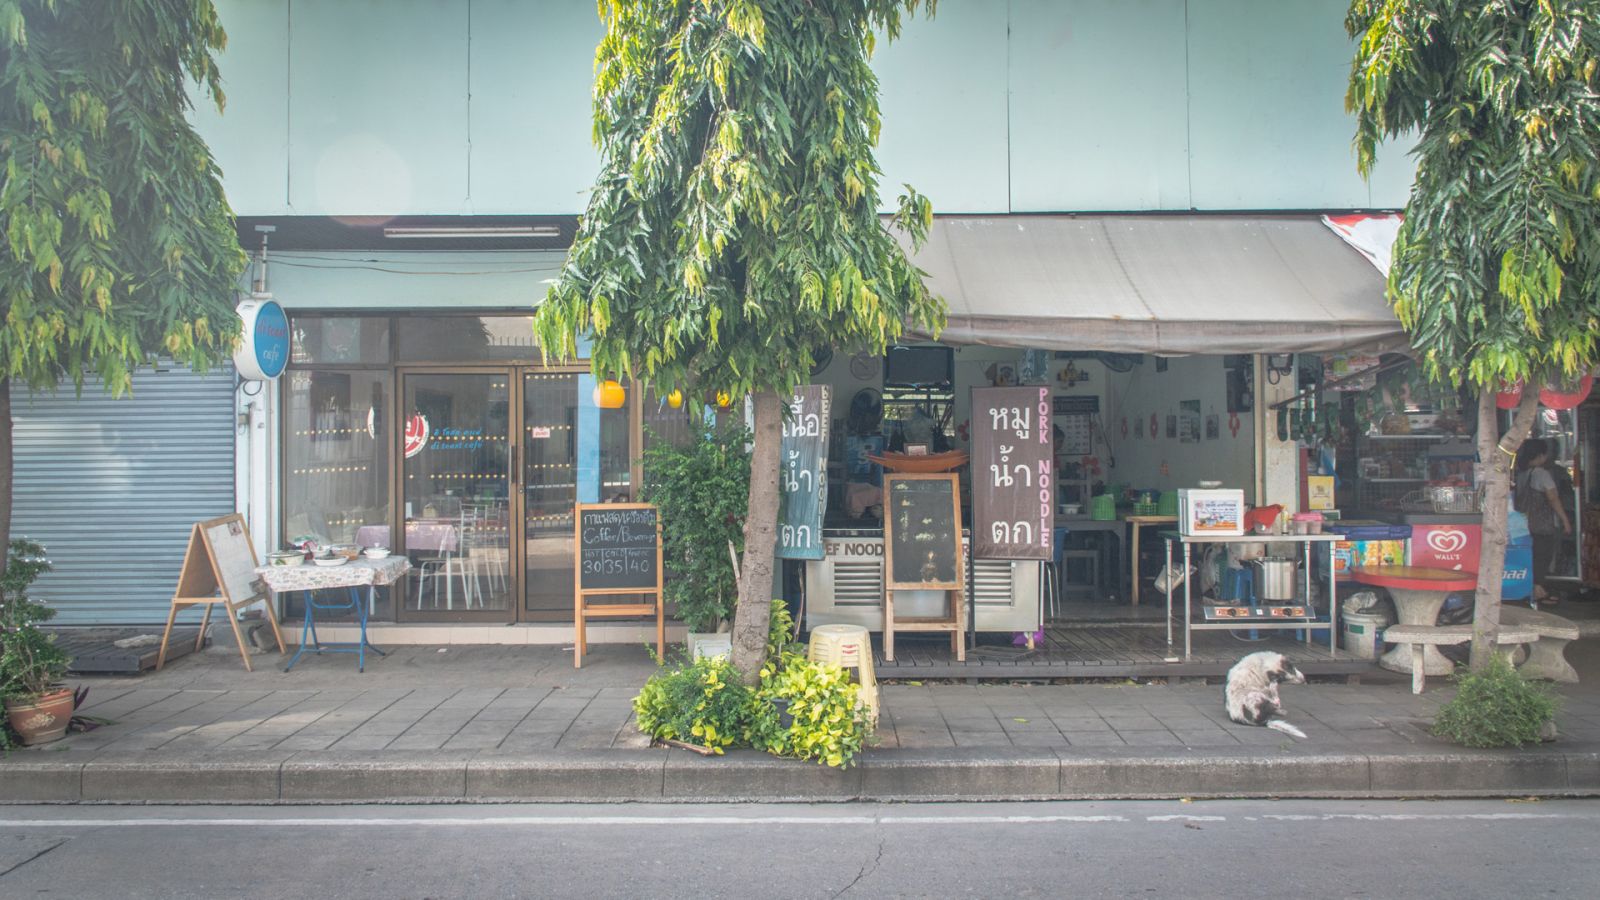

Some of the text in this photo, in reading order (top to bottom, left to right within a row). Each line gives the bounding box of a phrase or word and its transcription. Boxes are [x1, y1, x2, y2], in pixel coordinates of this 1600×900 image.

[821, 385, 829, 442] BEEF
[989, 407, 1030, 439] หมู
[784, 450, 811, 492] น้ำ
[990, 445, 1031, 487] น้ำ
[1039, 388, 1050, 547] PORK NOODLE
[782, 525, 810, 548] ตก
[992, 521, 1032, 544] ตก
[844, 543, 884, 556] NOOD
[584, 559, 649, 574] 30 35 40
